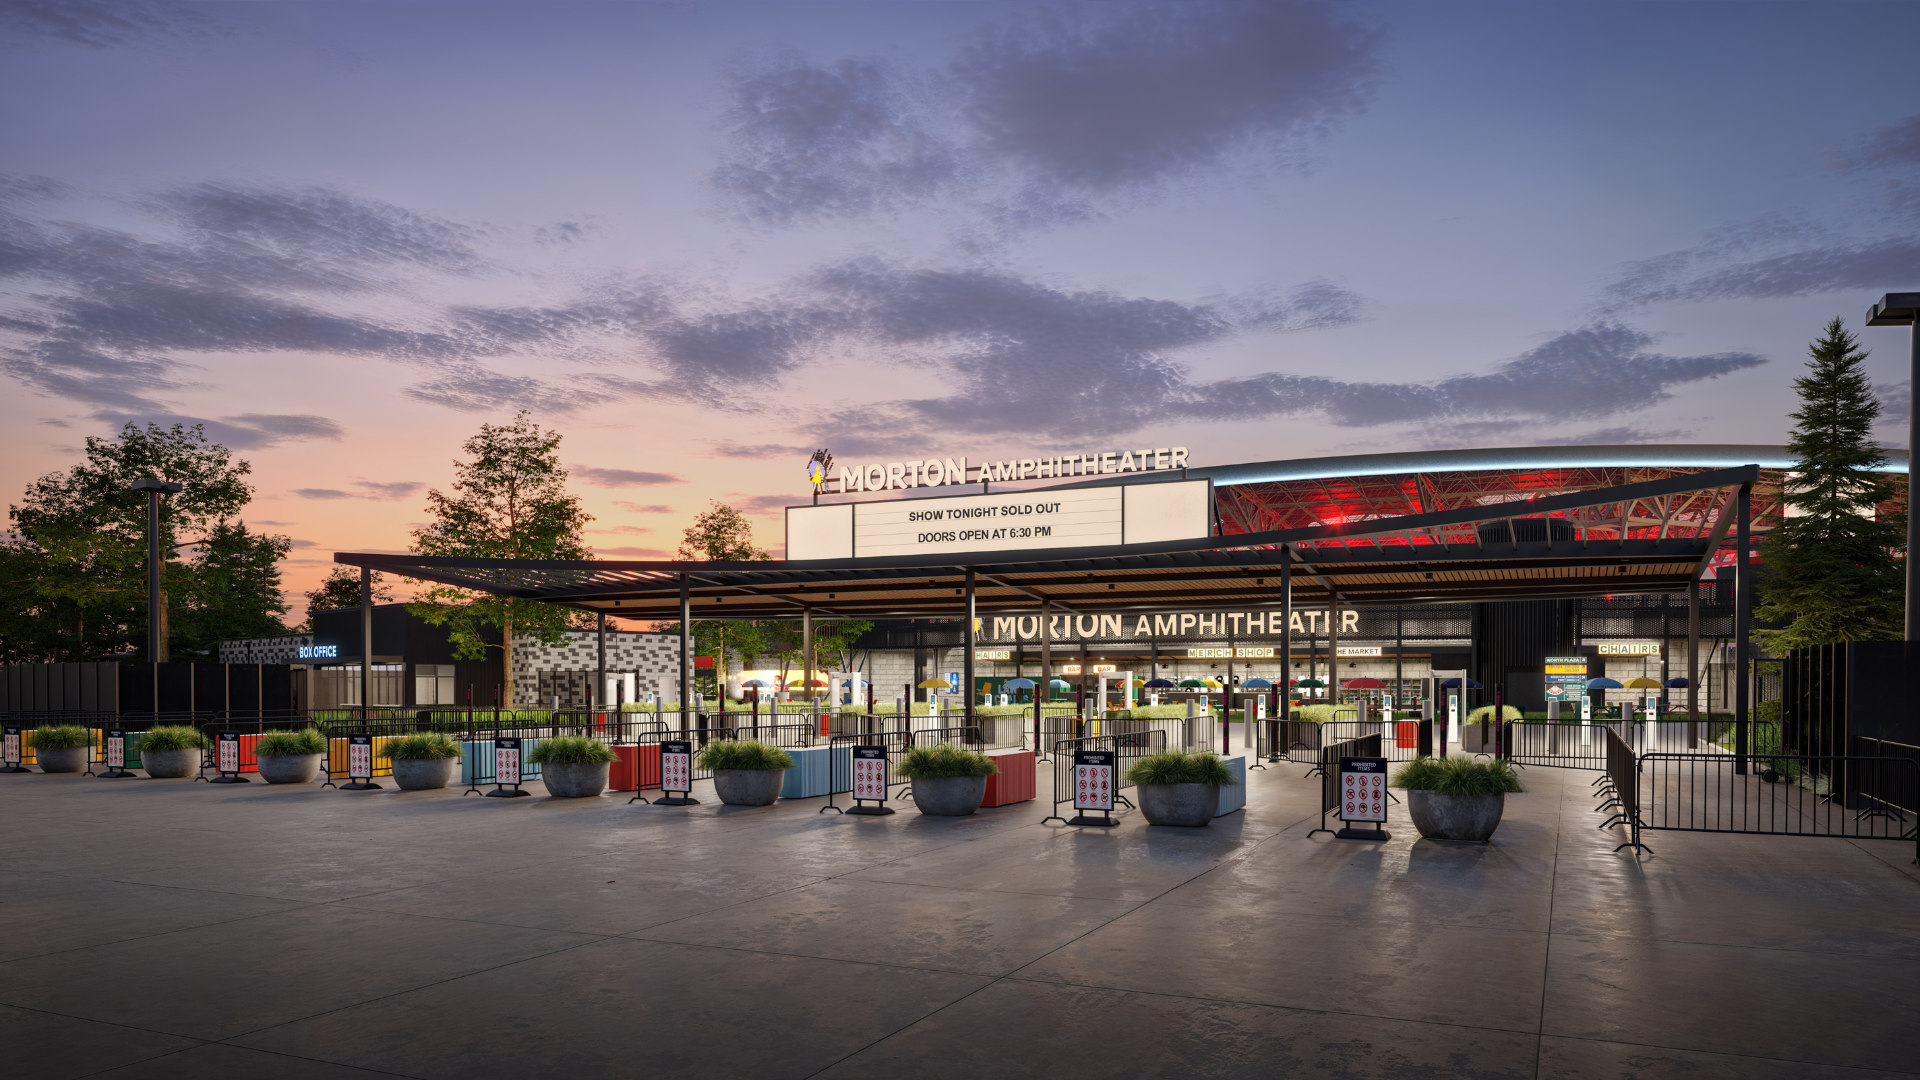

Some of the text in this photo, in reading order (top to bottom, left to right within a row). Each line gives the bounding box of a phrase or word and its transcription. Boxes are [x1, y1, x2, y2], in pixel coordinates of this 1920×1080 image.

[839, 446, 1189, 493] MORTON AMPHITHEATER
[909, 502, 1061, 522] SHOW TONIGHT SOLD OUT
[918, 526, 1051, 543] DOORS OPEN AT 6:30 PM
[299, 645, 337, 659] BOX OFFICE
[976, 651, 1009, 659] HAIRS
[1188, 648, 1273, 657] MERCH SHOP
[1600, 645, 1658, 654] CHAIRS
